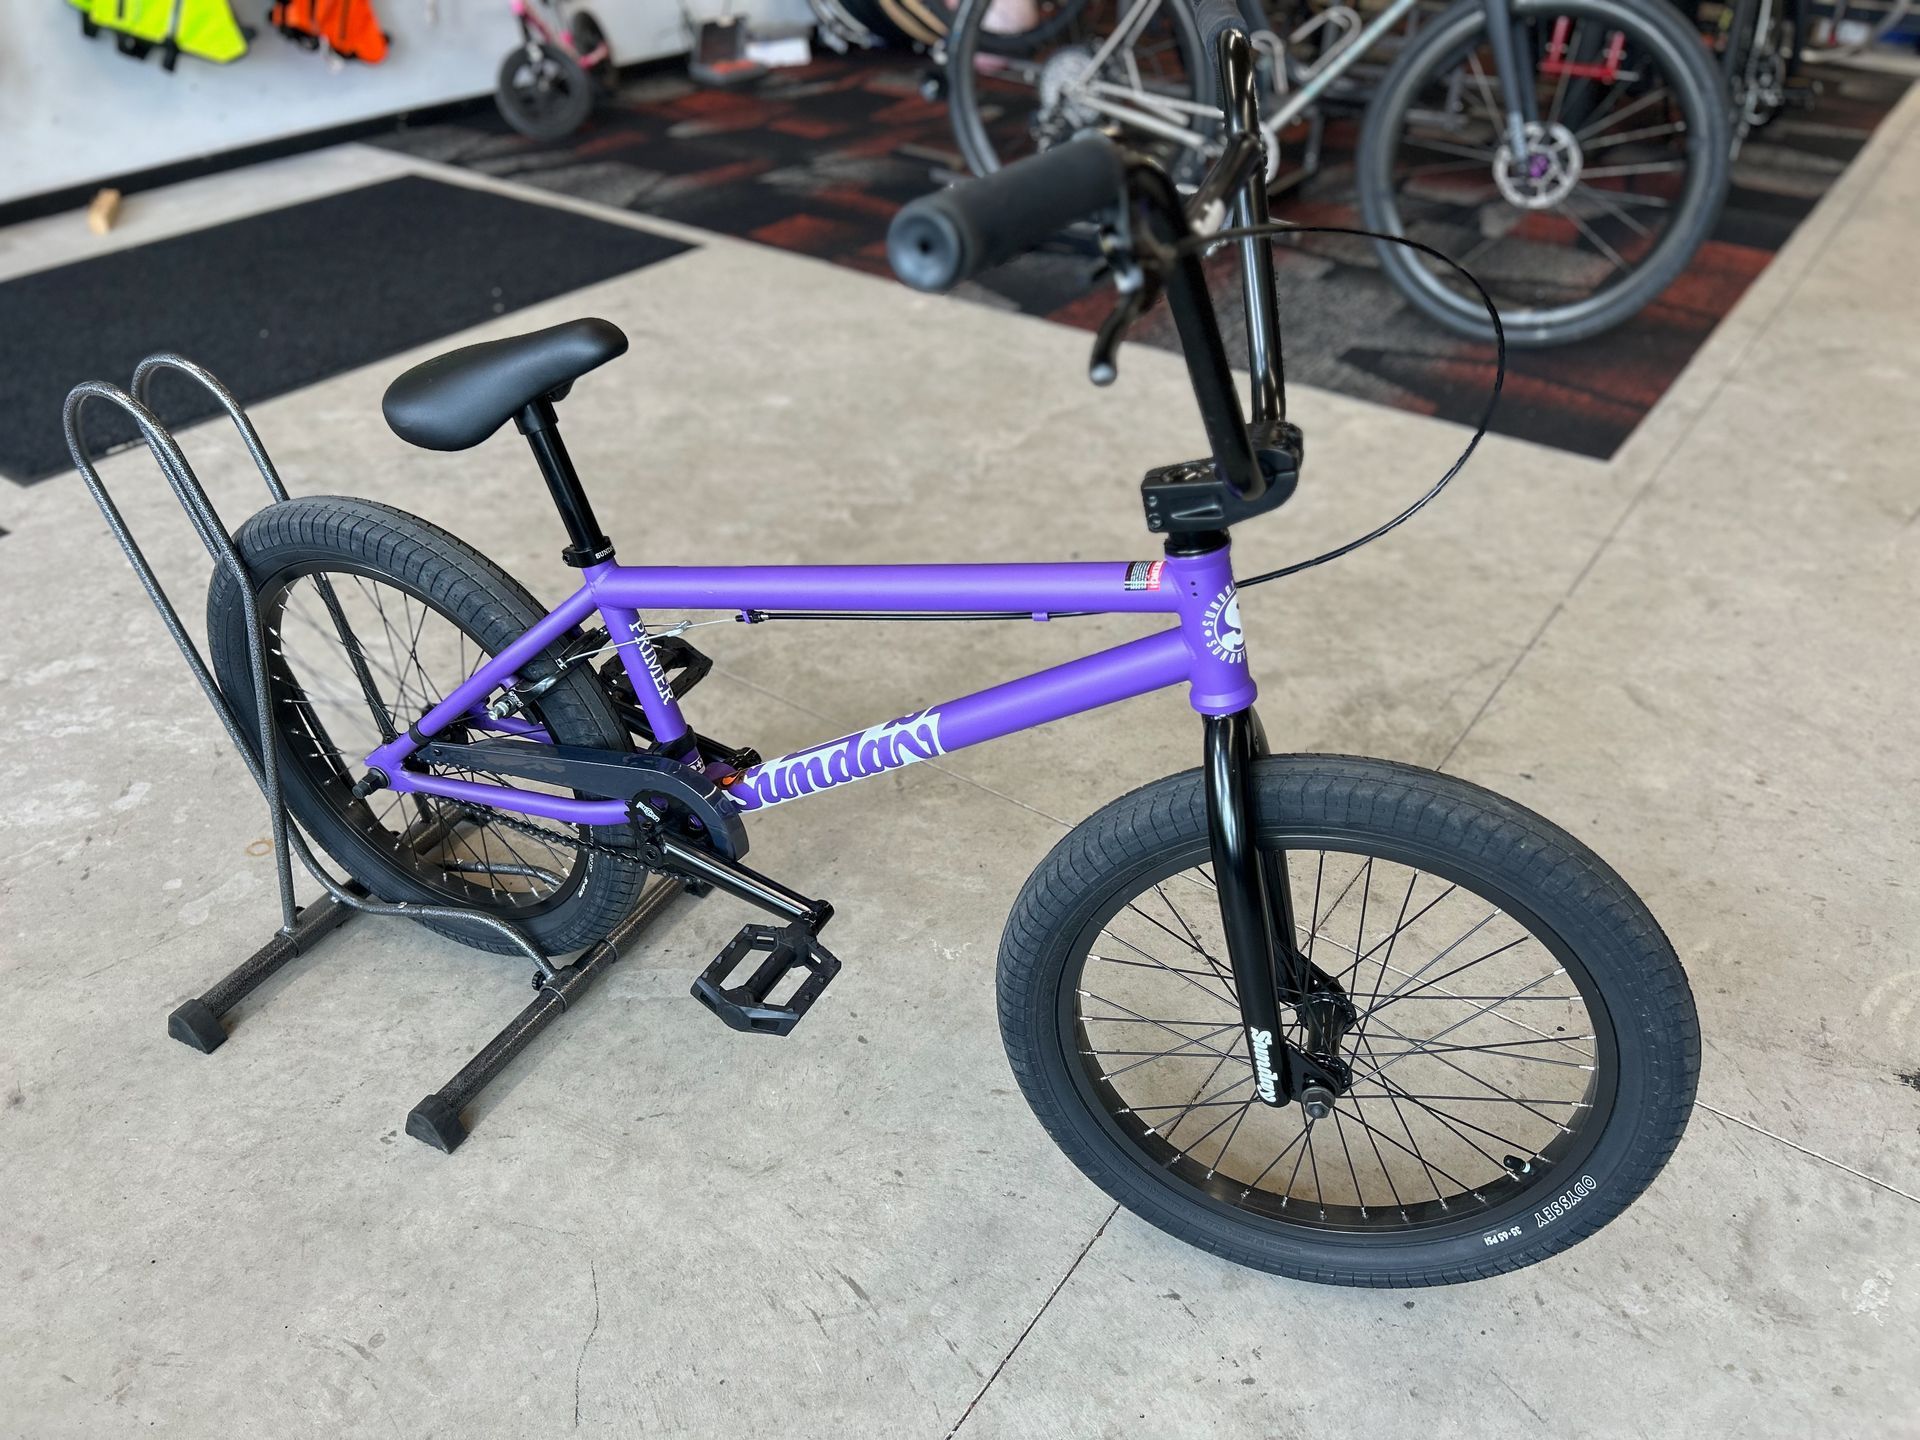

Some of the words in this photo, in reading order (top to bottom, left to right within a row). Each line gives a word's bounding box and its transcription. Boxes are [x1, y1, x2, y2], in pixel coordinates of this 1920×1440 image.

[629, 618, 675, 706] PRIMER
[1250, 1026, 1279, 1103] Sunday
[1534, 1174, 1597, 1228] ODYSSEY
[1484, 1234, 1499, 1247] PSI
